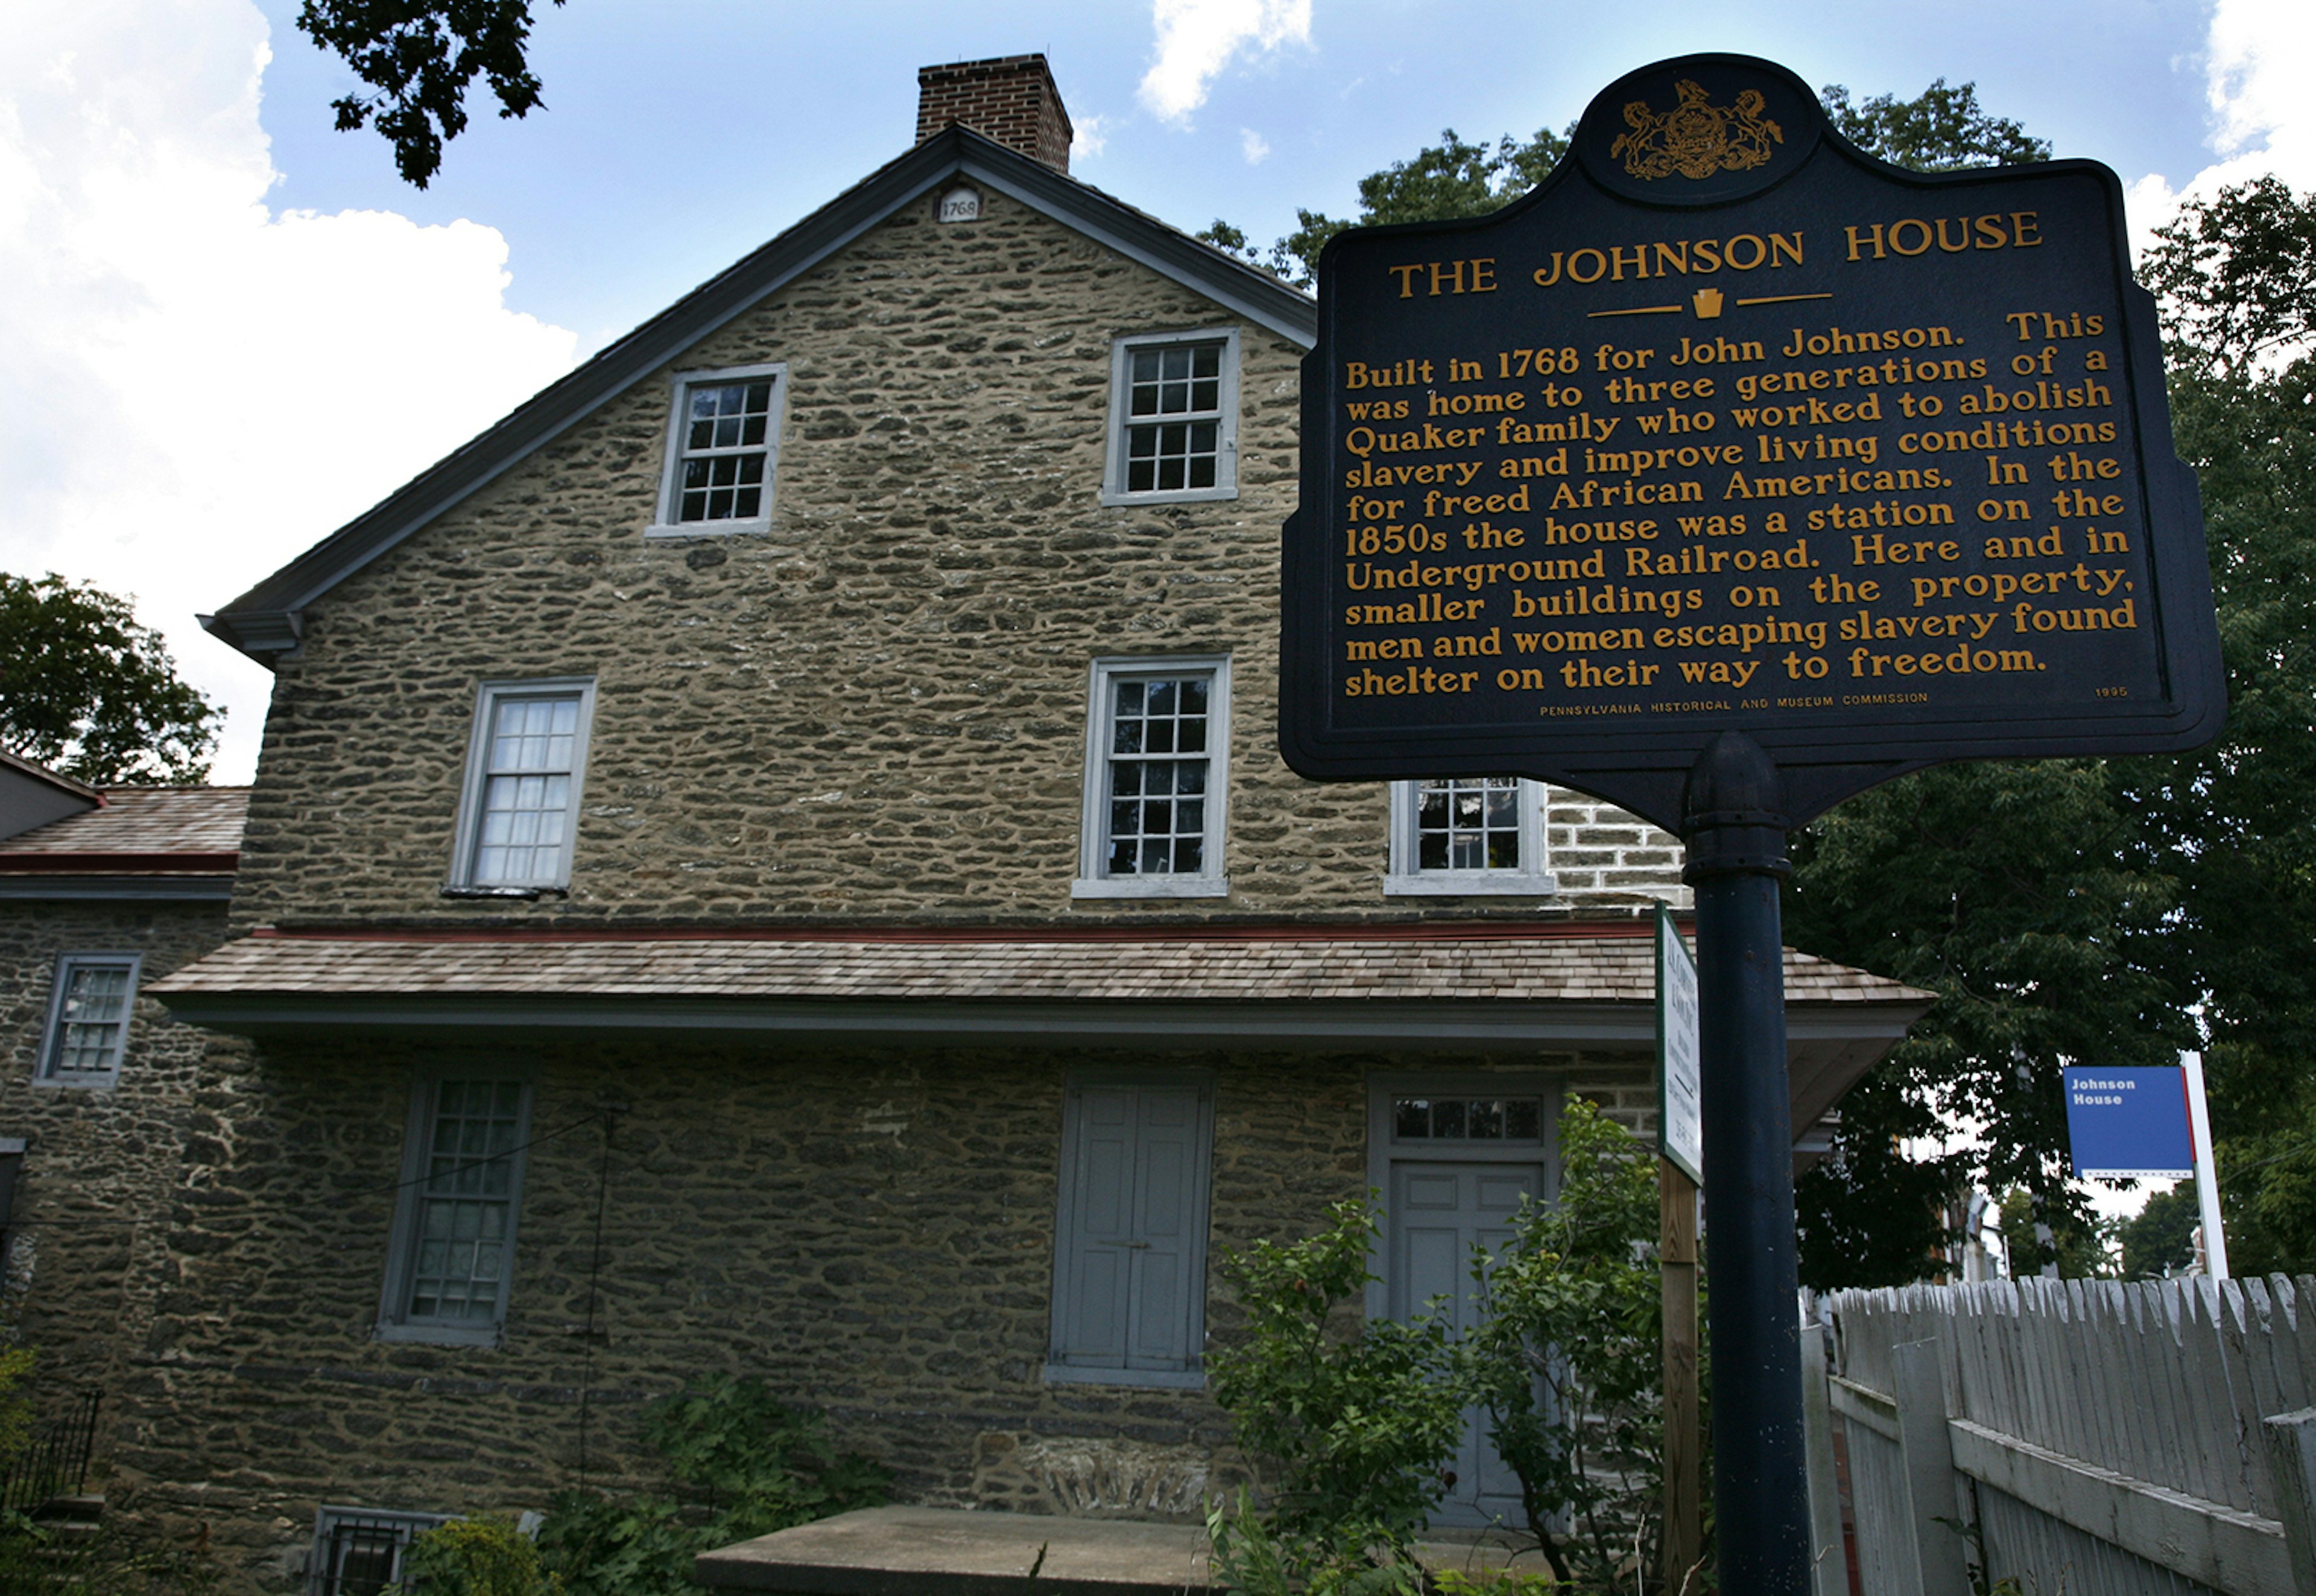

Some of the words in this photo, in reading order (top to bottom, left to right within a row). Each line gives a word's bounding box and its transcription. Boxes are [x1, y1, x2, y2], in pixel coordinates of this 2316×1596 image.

[944, 201, 975, 216] 1768
[1389, 258, 1498, 298] THE
[1534, 231, 1803, 286] JOHNSON
[1845, 212, 2043, 261] HOUSE
[1347, 359, 1434, 389] Built
[1449, 358, 1484, 382] in
[1499, 347, 1580, 379] 1768
[1595, 344, 1655, 371] for
[1671, 337, 1765, 365] John
[1783, 327, 1964, 357] Johnson.
[2007, 312, 2104, 341] This
[1347, 400, 1410, 420] was
[1428, 391, 1526, 416] home
[1542, 382, 1583, 408] to
[1604, 376, 1715, 403] three
[1736, 357, 1988, 402] generations
[2011, 346, 2058, 375] of
[2086, 350, 2108, 370] a
[1346, 423, 1486, 458] Quaker
[1496, 412, 1621, 444] family
[1636, 407, 1716, 434] who
[1731, 393, 1882, 428] worked
[1898, 392, 1943, 418] to
[1960, 378, 2112, 414] abolish
[1346, 461, 1483, 488] slavery
[1499, 447, 1569, 478] and
[1586, 445, 1744, 478] improve
[1758, 434, 1878, 464] living
[1898, 420, 2116, 454] conditions
[1347, 495, 1405, 522] for
[1423, 484, 1530, 517] freed
[1549, 479, 1704, 510] African
[1724, 467, 1952, 500] Americans.
[1987, 455, 2029, 485] In
[2048, 451, 2122, 481] the
[1346, 523, 1448, 557] 1850s
[1462, 522, 1525, 549] the
[1545, 517, 1659, 545] house
[1677, 514, 1747, 537] was
[1765, 511, 1788, 533] a
[1808, 500, 1955, 531] station
[1977, 499, 2031, 522] on
[2051, 488, 2125, 517] the
[1346, 549, 1606, 591] Underground
[1625, 538, 1820, 577] Railroad.
[1852, 533, 1960, 566] Here
[1985, 525, 2064, 558] and
[2087, 526, 2129, 554] in
[1346, 593, 1485, 625] smaller
[1512, 584, 1704, 619] buildings
[1730, 585, 1781, 607] on
[1809, 573, 1881, 604] the
[1911, 563, 2134, 607] property,
[1346, 637, 1424, 661] men
[1433, 626, 1502, 657] and
[1513, 628, 1645, 654] women
[1653, 615, 1827, 654] escaping
[1840, 610, 1999, 641] slavery
[2010, 598, 2137, 633] found
[1346, 666, 1479, 696] shelter
[1496, 669, 1545, 690] on
[1560, 658, 1660, 688] their
[1678, 660, 1761, 687] way
[1782, 651, 1829, 680] to
[1848, 643, 2046, 677] freedom.
[1540, 704, 1642, 716] PENNSYLVANIA
[1651, 701, 1731, 713] HISTORICAL
[1741, 698, 1768, 710] AND
[1777, 696, 1834, 708] MUSEUM
[1842, 693, 1929, 705] COMMISSION
[2072, 1079, 2135, 1090] Johnson
[2074, 1094, 2122, 1105] House
